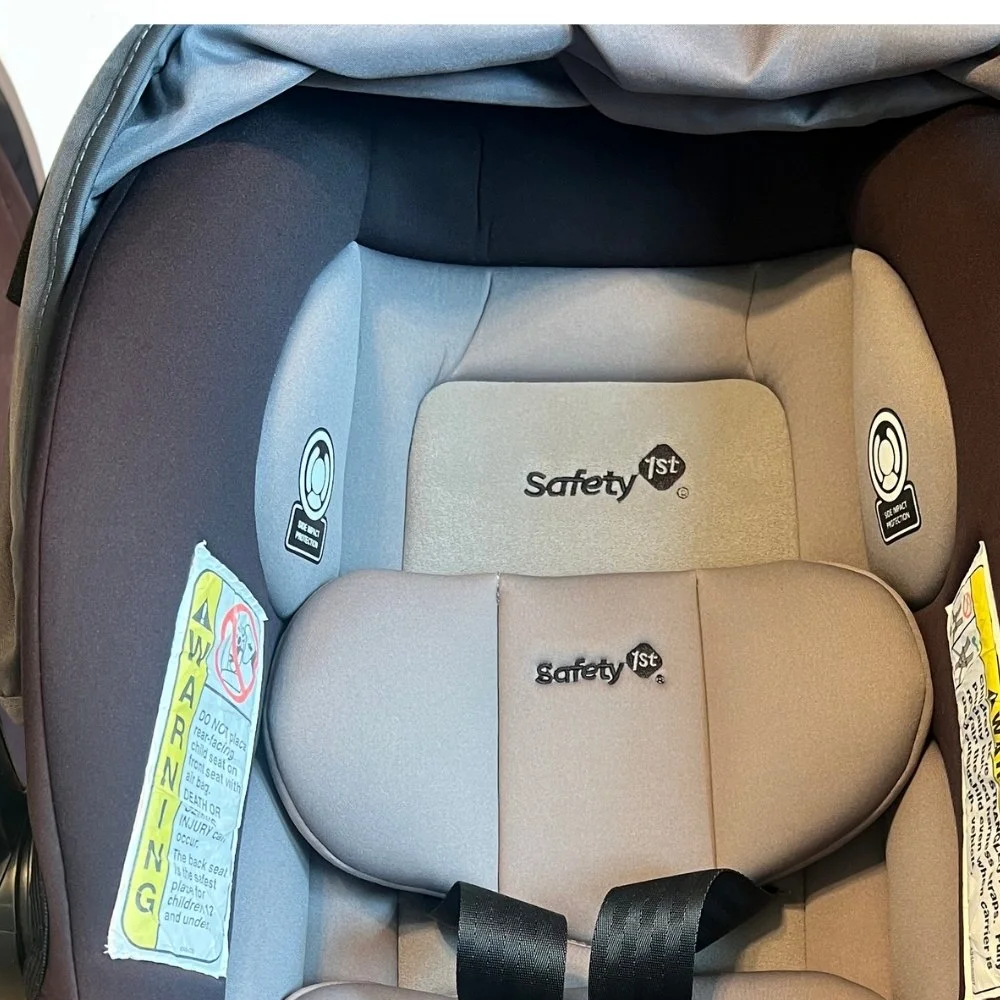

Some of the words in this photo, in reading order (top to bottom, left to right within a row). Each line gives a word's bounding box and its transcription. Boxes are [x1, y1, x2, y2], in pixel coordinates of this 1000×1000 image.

[524, 468, 638, 503] Safety
[642, 453, 682, 482] 1st
[535, 656, 625, 686] Safety
[629, 648, 661, 673] 1st
[199, 709, 211, 726] DO
[194, 726, 235, 761] rear-facing
[191, 741, 208, 759] child
[209, 753, 226, 770] seat
[227, 764, 238, 777] on
[135, 629, 211, 918] WARNING
[186, 771, 196, 784] air
[205, 768, 223, 784] seat
[225, 777, 242, 794] with
[179, 814, 214, 836] INJURY
[210, 803, 221, 819] OR
[176, 832, 199, 848] occur.
[173, 848, 187, 863] The
[188, 854, 207, 871] back
[208, 864, 228, 878] seat
[164, 911, 181, 923] and
[980, 901, 990, 952] carrier
[986, 957, 993, 970] is
